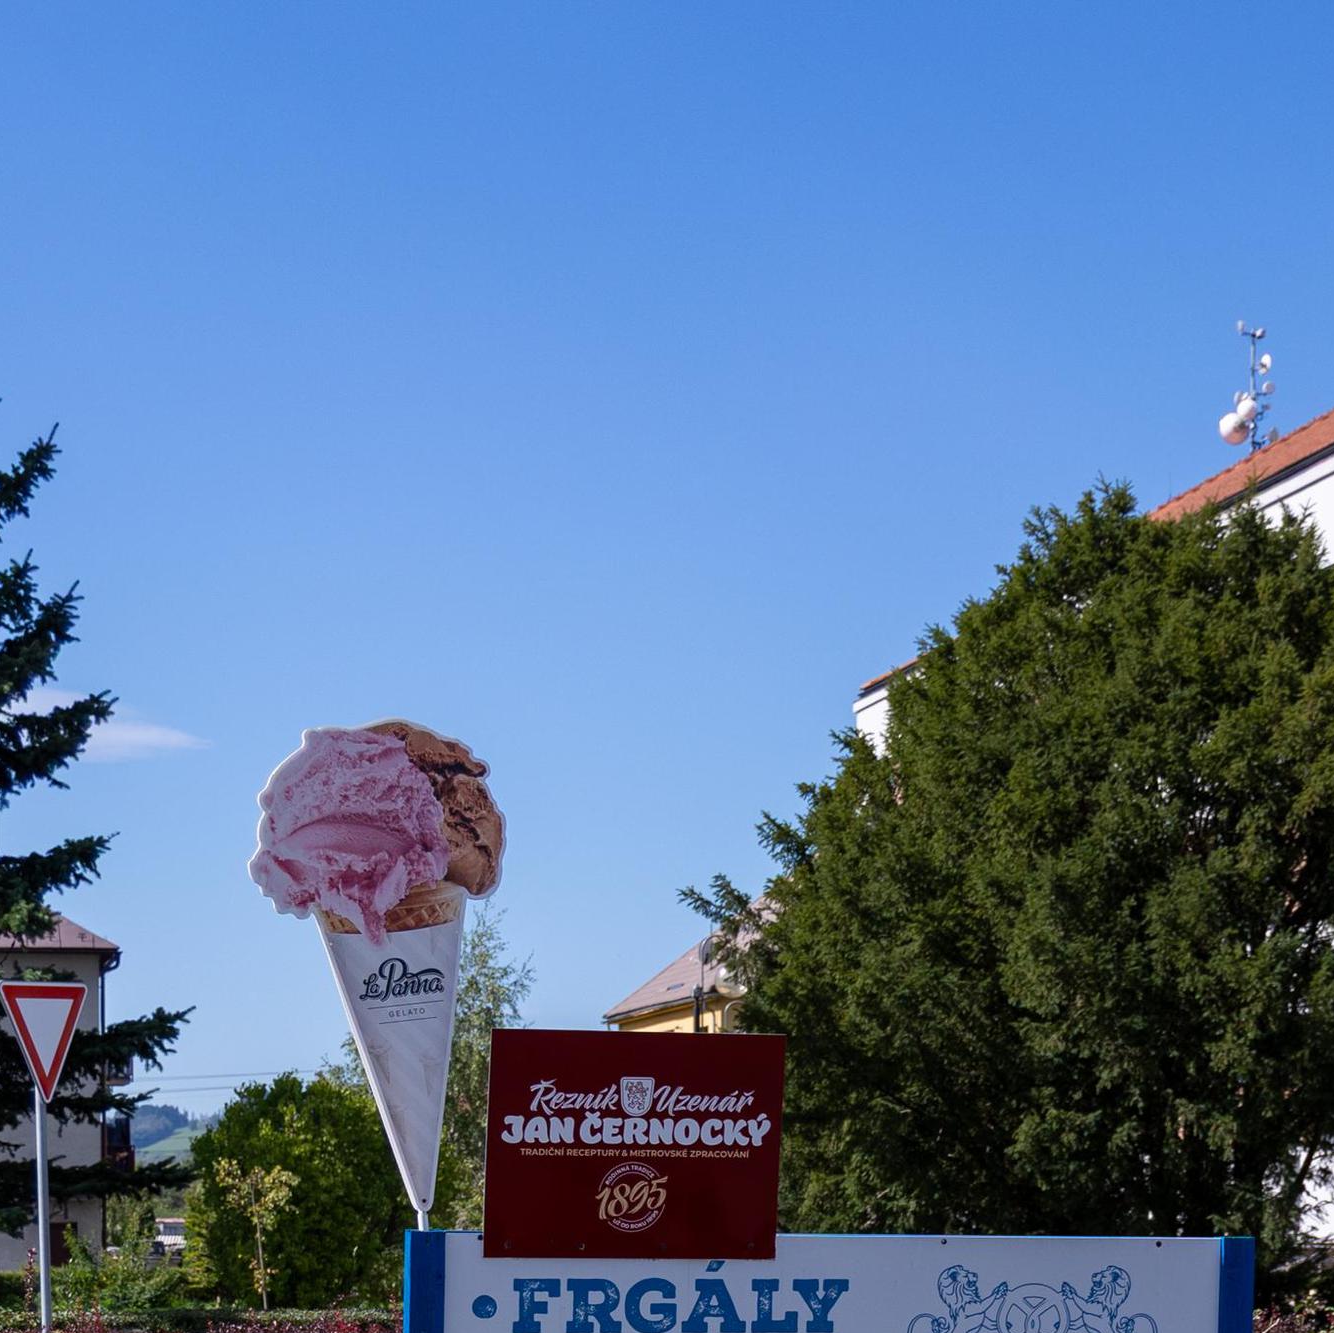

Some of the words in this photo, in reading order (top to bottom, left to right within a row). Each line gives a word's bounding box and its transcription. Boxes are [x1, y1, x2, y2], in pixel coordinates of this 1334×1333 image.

[359, 973, 383, 1001] La
[378, 957, 445, 1002] Panna
[388, 1007, 426, 1018] GELATO
[530, 1079, 618, 1116] Řezník
[653, 1085, 755, 1117] Uzenář
[501, 1115, 575, 1145] JAN
[579, 1111, 772, 1147] ČERNOCKÝ
[520, 1147, 565, 1157] TRADIČNÍ
[567, 1148, 620, 1158] RECEPTURY
[621, 1150, 628, 1158] &
[629, 1147, 688, 1159] MISTROVSKÉ
[689, 1148, 749, 1159] ZPRACOVÁNÍ
[595, 1176, 668, 1220] 1895
